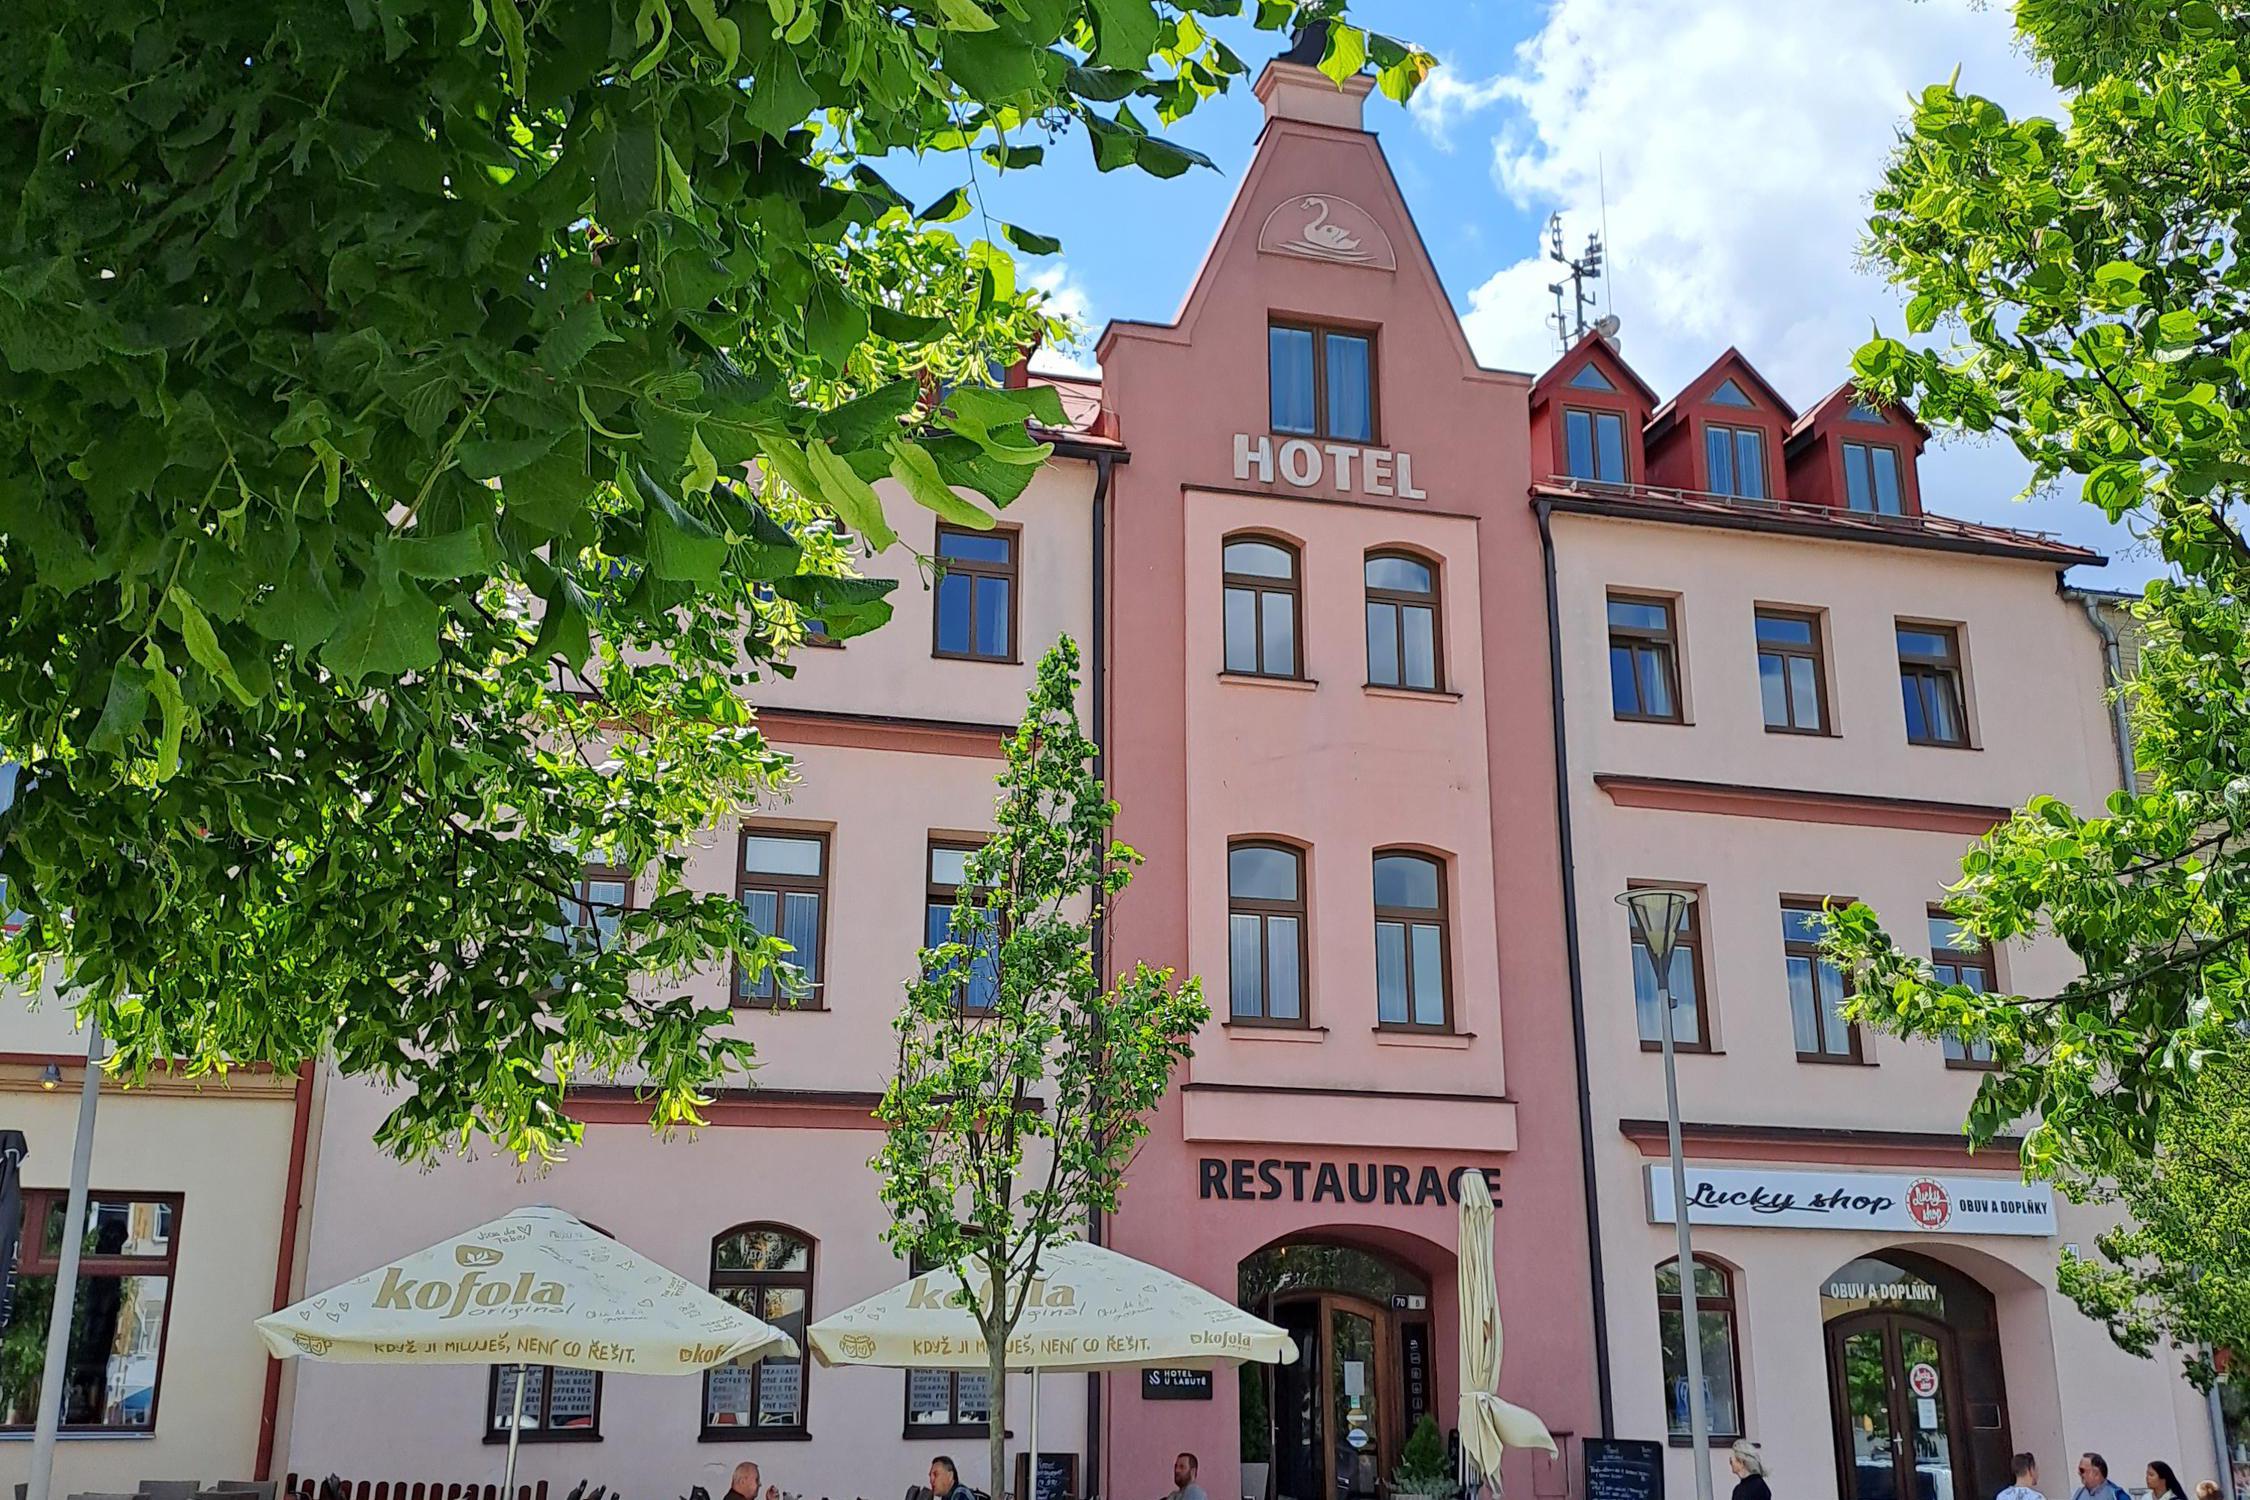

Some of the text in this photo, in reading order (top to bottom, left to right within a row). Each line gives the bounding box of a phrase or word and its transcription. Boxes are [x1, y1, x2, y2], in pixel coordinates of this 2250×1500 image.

[1233, 433, 1427, 500] HOTEL
[1686, 1182, 1896, 1215] Lucky shop
[1912, 1186, 1943, 1207] Lucky
[1922, 1207, 1942, 1224] shop
[1959, 1199, 2047, 1215] OBUV A DOPLŇKY
[371, 1267, 566, 1319] kofola
[1830, 1281, 1937, 1301] OBUV A DOPLŇKY
[468, 1302, 576, 1320] original
[1395, 1297, 1406, 1308] 70
[424, 1343, 437, 1353] JI
[445, 1331, 511, 1354] MILUJEŠ,
[517, 1337, 559, 1356] NENÍ
[563, 1341, 581, 1357] CO
[588, 1339, 636, 1364] ŘEŠIT.
[913, 1335, 952, 1356] KDYŽ
[957, 1340, 969, 1354] JI
[1041, 1337, 1078, 1355] NENÍ
[1083, 1338, 1100, 1353] CO
[1106, 1334, 1150, 1352] ŘEŠIT.
[1203, 1330, 1252, 1349] kofola
[1164, 1370, 1193, 1378] HOTEL
[1164, 1377, 1170, 1386] U
